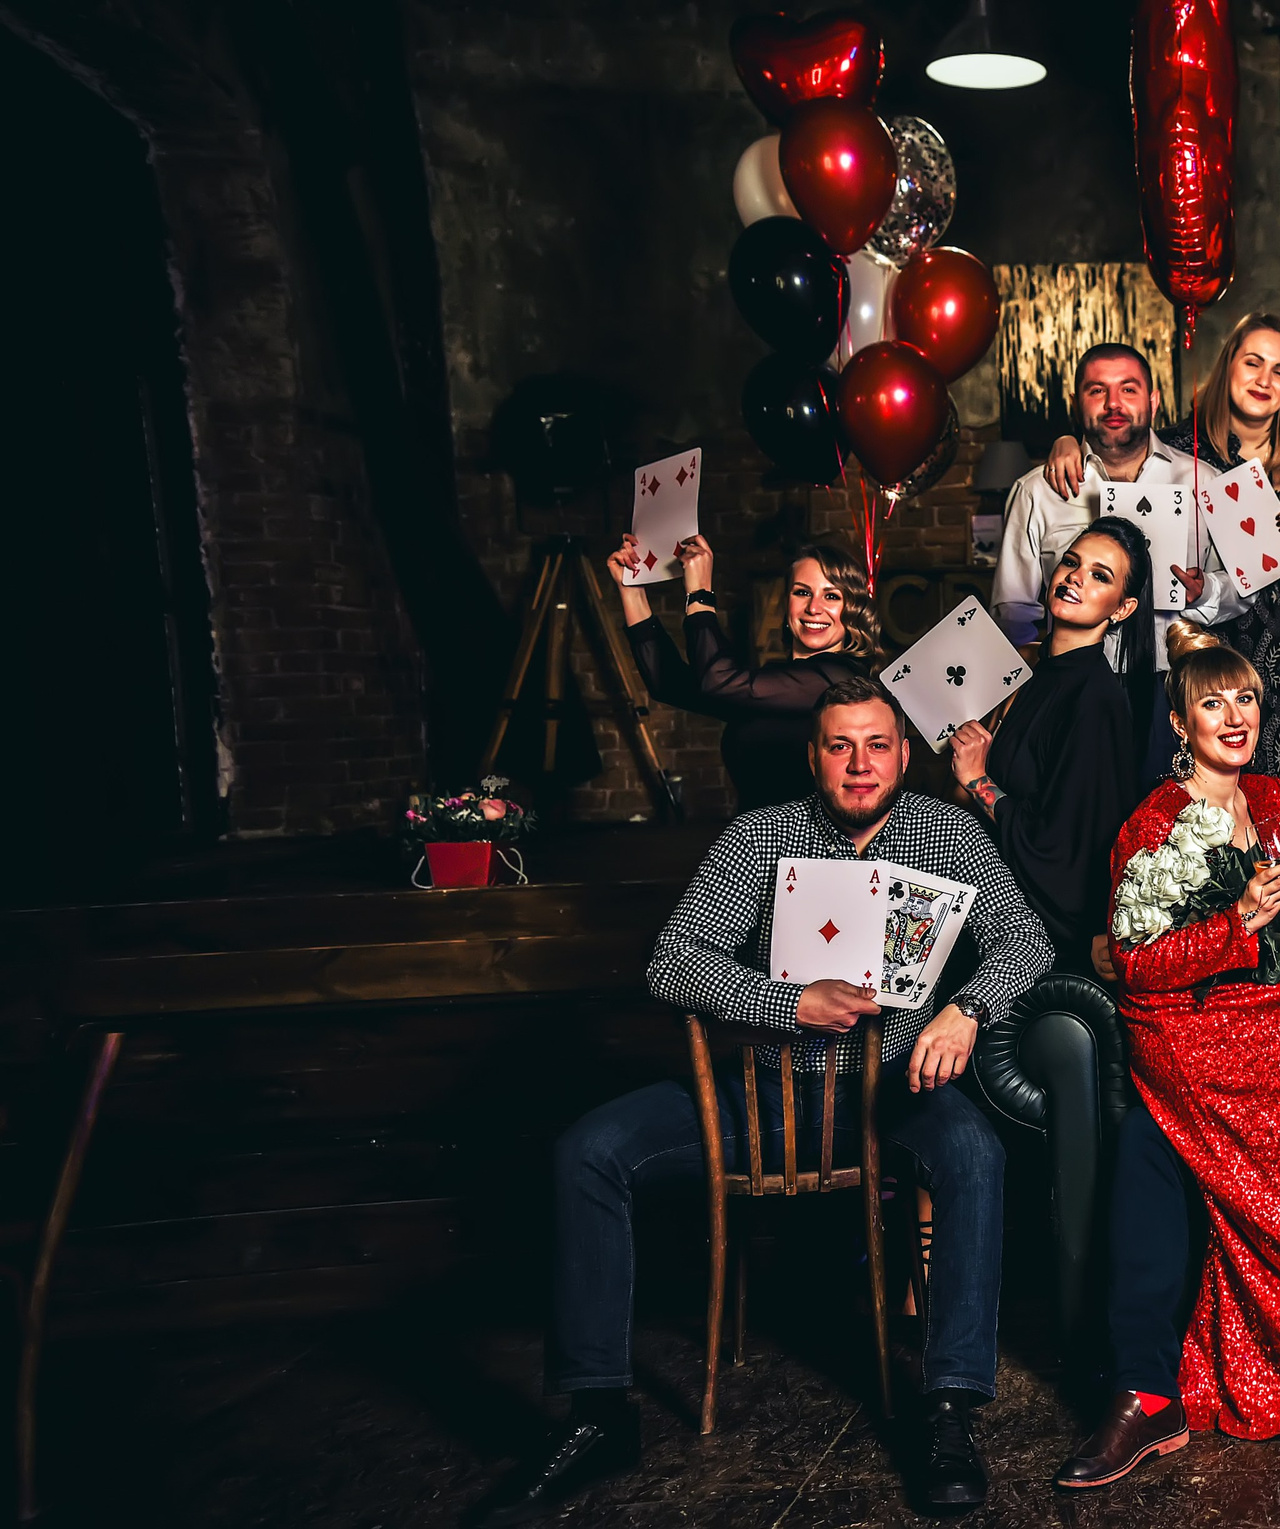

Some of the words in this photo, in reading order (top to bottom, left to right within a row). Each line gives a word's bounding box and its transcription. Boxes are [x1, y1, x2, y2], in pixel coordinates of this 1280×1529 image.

[690, 456, 696, 469] 4
[1250, 466, 1260, 479] 3
[640, 473, 647, 486] 4
[1106, 488, 1116, 502] 3
[1173, 490, 1183, 504] 3
[1201, 490, 1211, 504] 3
[1240, 577, 1251, 590] 3
[1169, 590, 1178, 603] 3
[964, 607, 977, 620] A
[892, 669, 905, 683] A
[1010, 667, 1023, 680] A
[936, 729, 949, 741] A
[785, 866, 798, 881] A
[869, 869, 881, 884] A
[956, 890, 968, 905] K
[909, 991, 922, 1004] K
